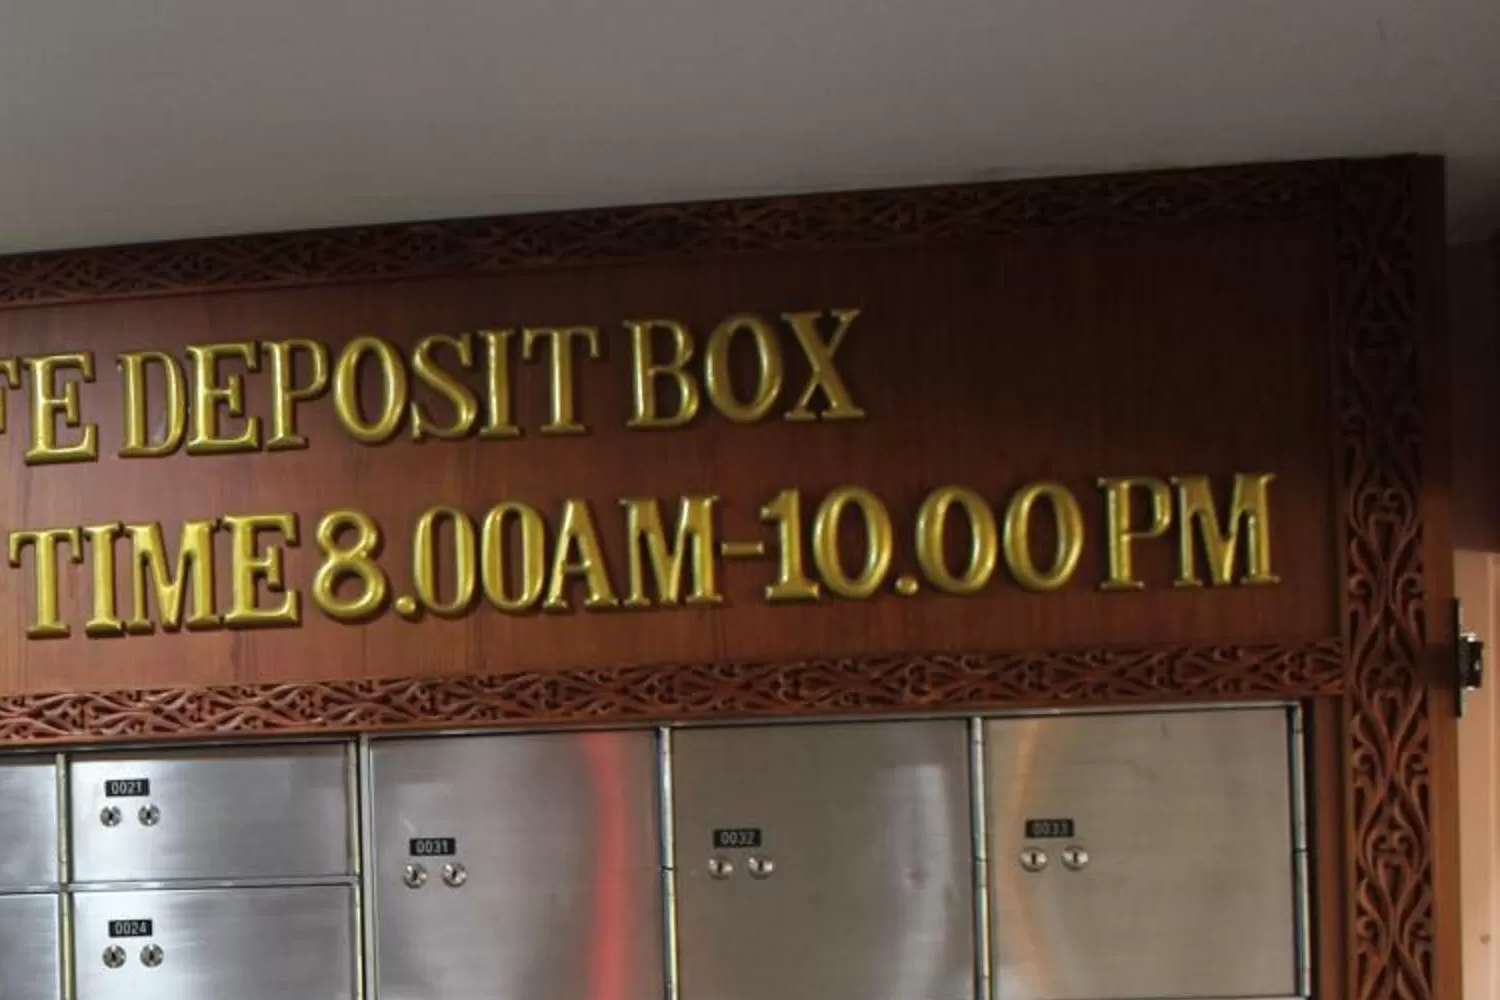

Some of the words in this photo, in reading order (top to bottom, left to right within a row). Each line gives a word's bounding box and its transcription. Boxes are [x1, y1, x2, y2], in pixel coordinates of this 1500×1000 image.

[118, 325, 600, 458] DEPOSIT
[624, 307, 865, 430] BOX
[9, 511, 303, 638] TIME
[1094, 471, 1280, 591] PM
[111, 781, 143, 795] 0021
[719, 831, 756, 846] 0032
[415, 839, 449, 854] 0031
[114, 922, 147, 936] 0024
